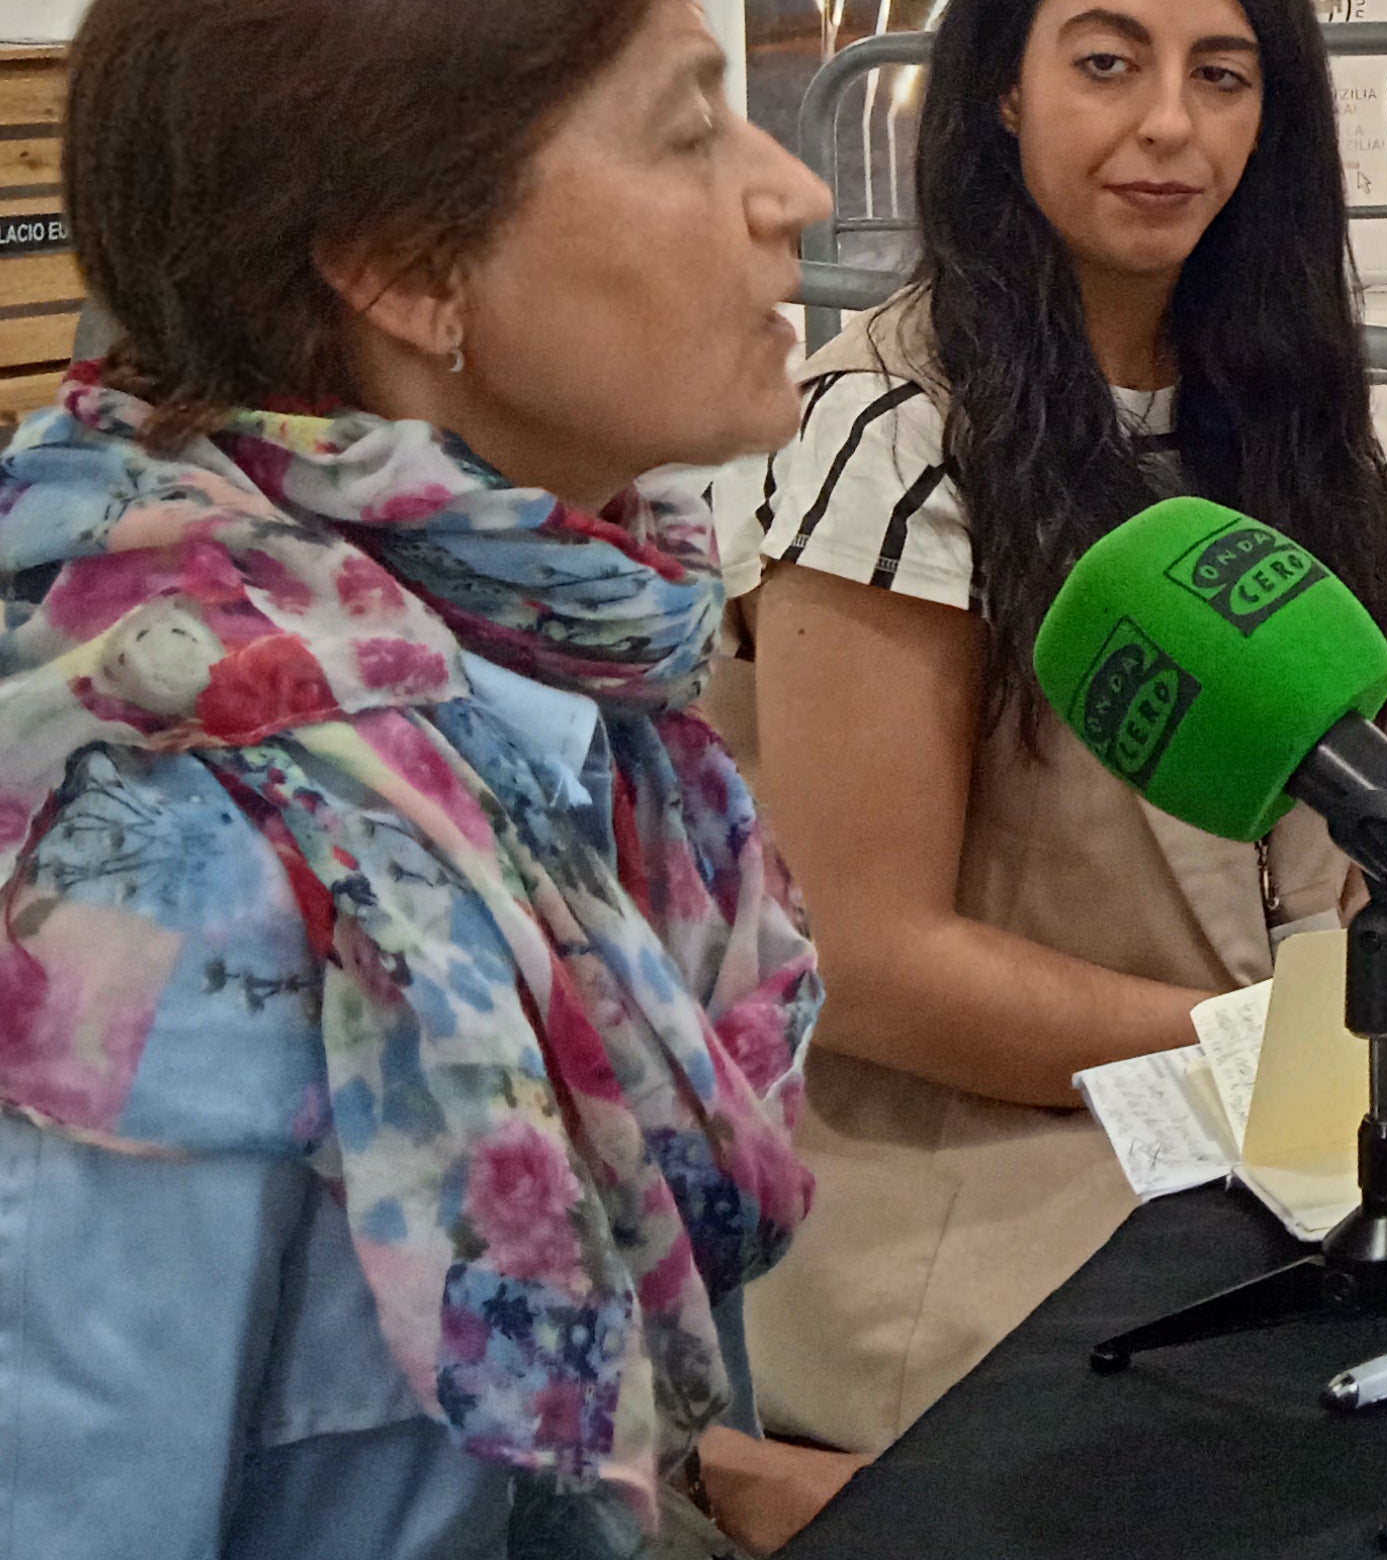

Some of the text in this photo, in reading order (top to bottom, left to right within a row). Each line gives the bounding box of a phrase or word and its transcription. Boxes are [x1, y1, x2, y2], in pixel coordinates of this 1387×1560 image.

[1200, 531, 1277, 580] ONDA
[1238, 553, 1305, 605] CERO
[1118, 680, 1170, 760] CERO
